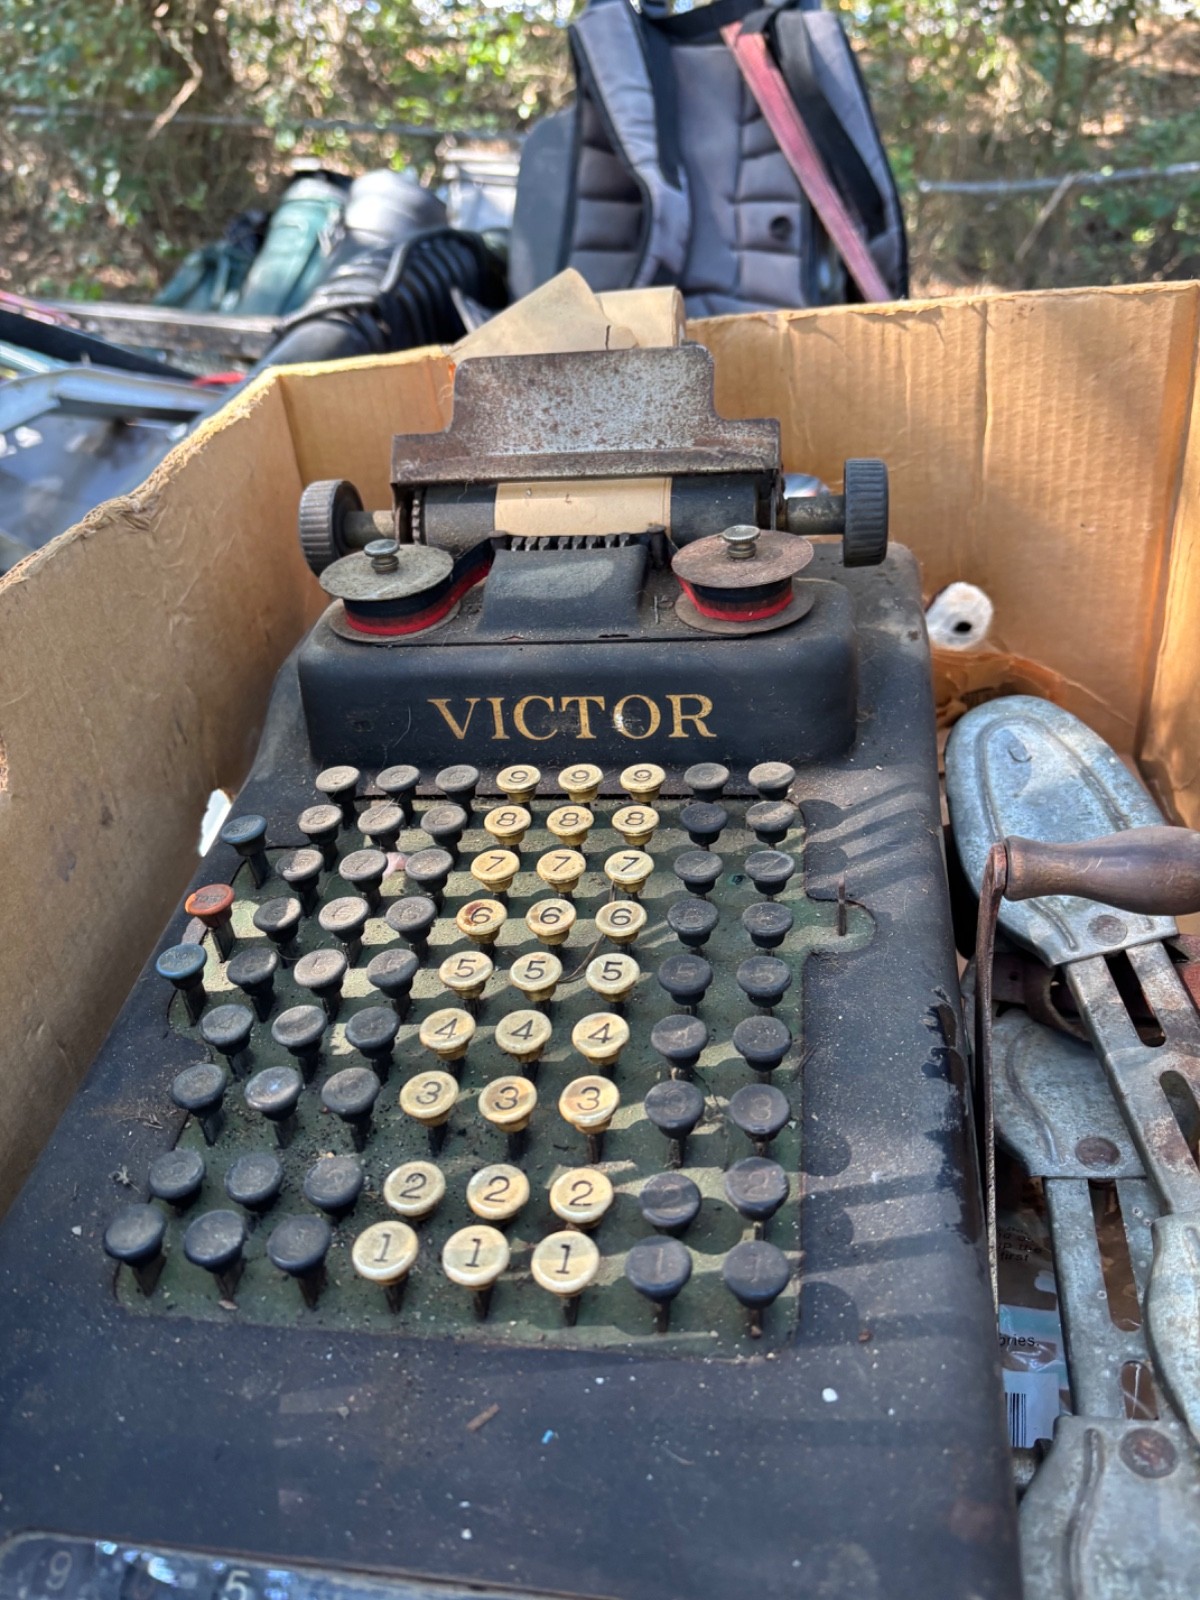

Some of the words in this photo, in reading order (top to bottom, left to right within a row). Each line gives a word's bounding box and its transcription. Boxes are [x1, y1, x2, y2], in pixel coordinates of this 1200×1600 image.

[427, 694, 717, 740] VICTOR
[508, 770, 529, 783] 9
[570, 769, 590, 783] 9
[633, 769, 652, 782] 9
[496, 812, 518, 827] 8
[558, 812, 580, 827] 8
[624, 811, 645, 826] 8
[485, 855, 507, 872] 7
[552, 855, 572, 872] 7
[620, 856, 640, 872] 7
[470, 906, 494, 925] 6
[539, 906, 564, 925] 6
[610, 907, 633, 926] 6
[454, 958, 477, 978] 5
[524, 960, 547, 980] 5
[601, 961, 624, 981] 5
[434, 1017, 458, 1039] 4
[510, 1019, 534, 1040] 4
[587, 1022, 613, 1044] 4
[415, 1081, 442, 1105] 3
[494, 1086, 519, 1111] 3
[576, 1086, 601, 1111] 3
[750, 1093, 773, 1121] 3
[399, 1172, 427, 1199] 2
[483, 1175, 510, 1203] 2
[568, 1180, 594, 1207] 2
[745, 1171, 770, 1197] 2
[373, 1233, 393, 1263] 1
[464, 1238, 482, 1268] 1
[555, 1244, 572, 1275] 1
[45, 1551, 72, 1591] 9
[223, 1570, 250, 1600] 5
